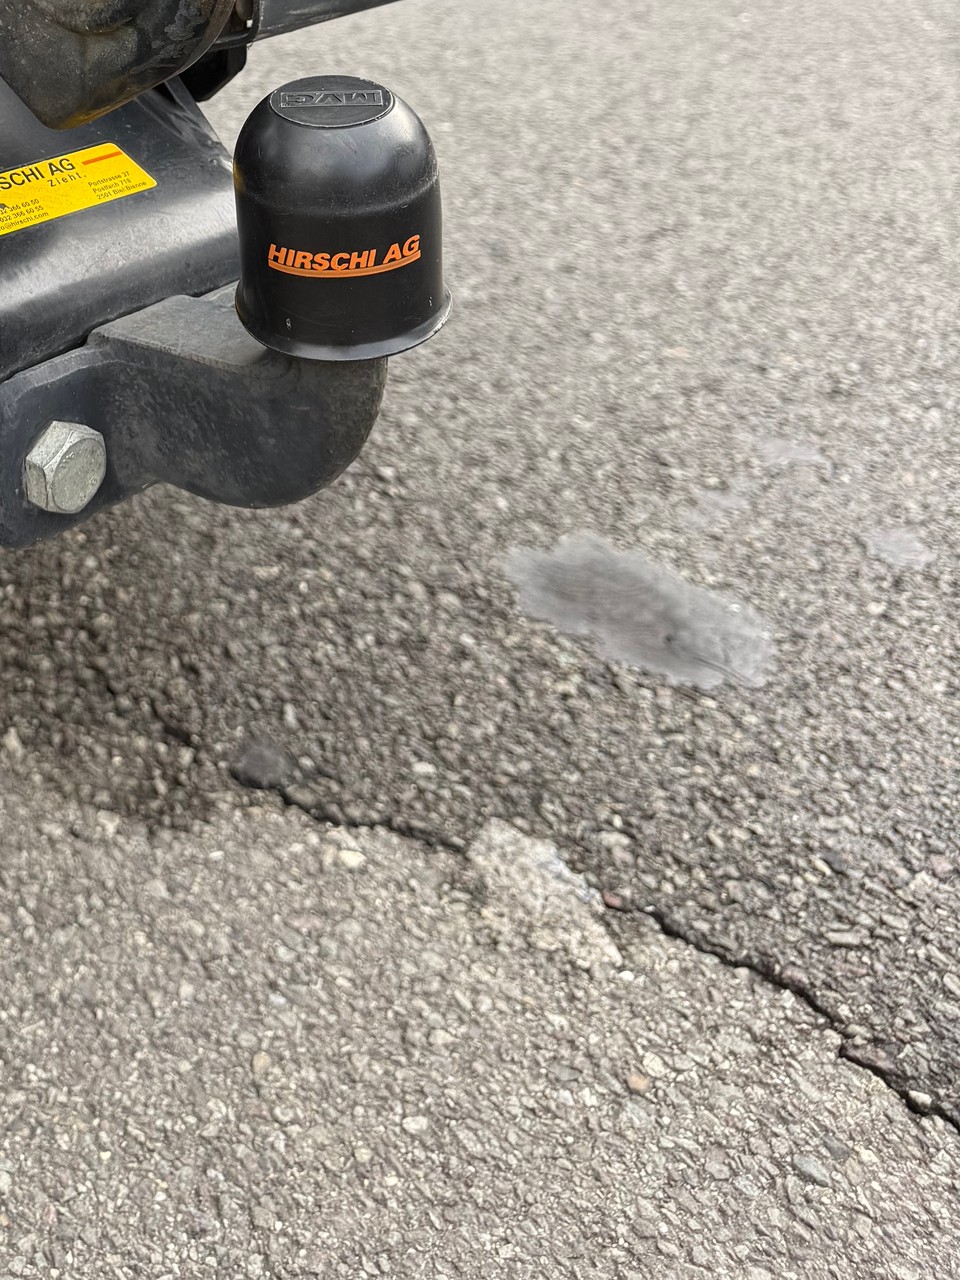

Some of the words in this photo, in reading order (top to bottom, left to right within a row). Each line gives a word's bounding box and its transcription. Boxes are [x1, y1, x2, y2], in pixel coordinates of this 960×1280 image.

[287, 91, 378, 104] MVG
[47, 157, 76, 176] AG
[47, 171, 87, 188] Zieht.
[268, 243, 377, 272] HIRSCHI
[383, 234, 420, 265] AG
